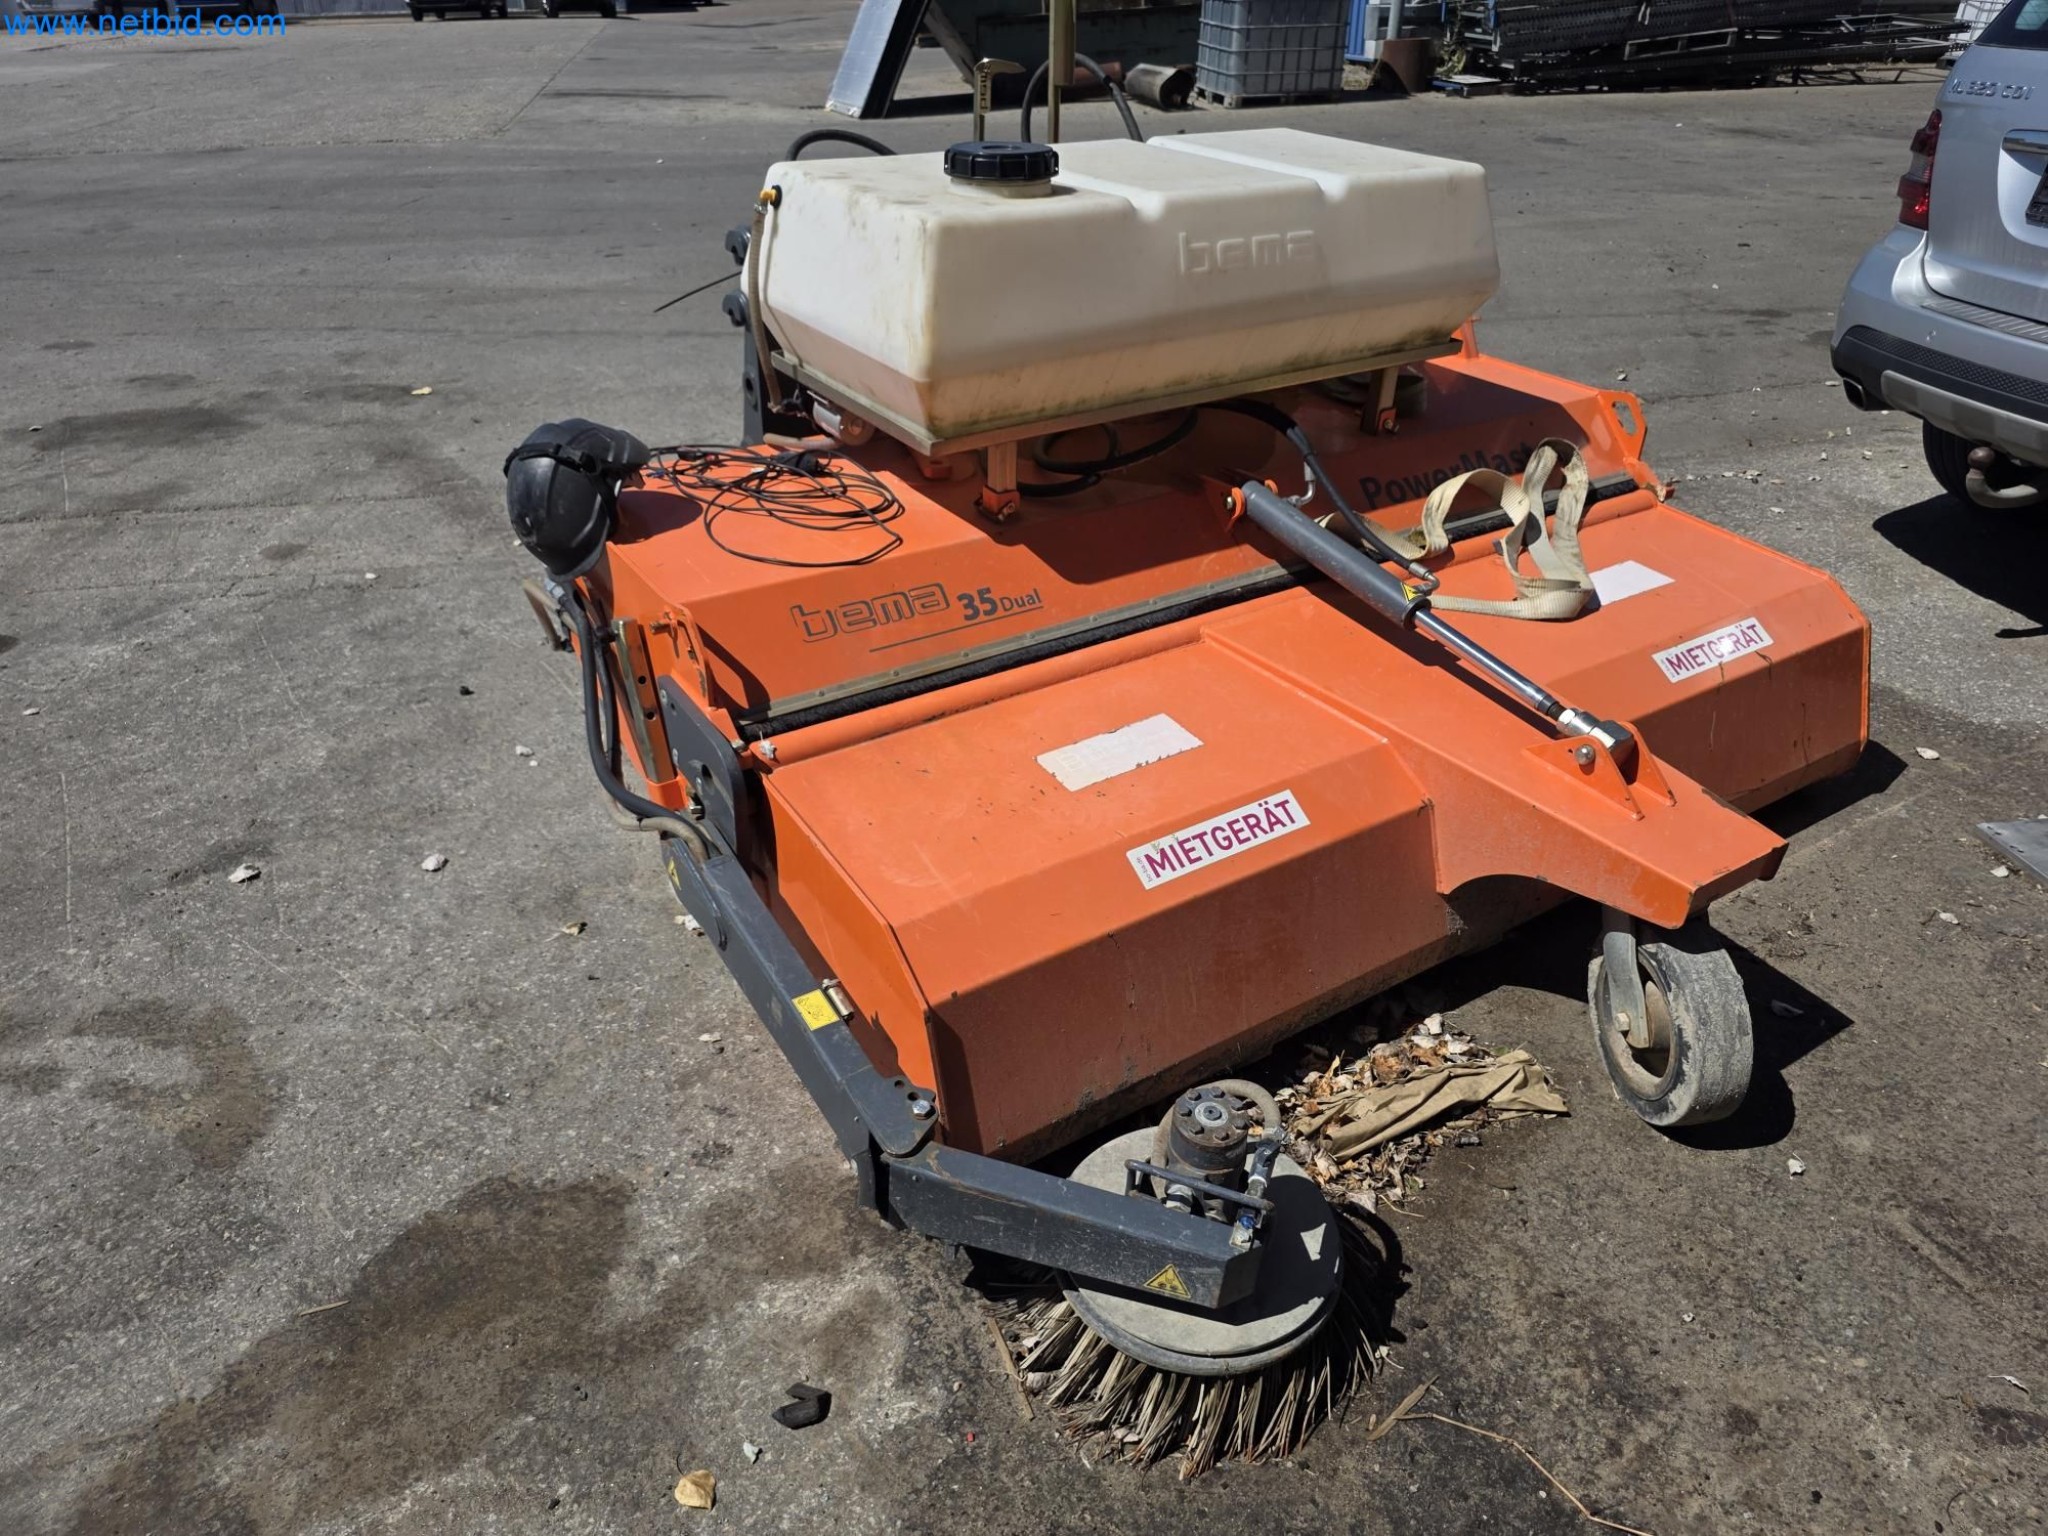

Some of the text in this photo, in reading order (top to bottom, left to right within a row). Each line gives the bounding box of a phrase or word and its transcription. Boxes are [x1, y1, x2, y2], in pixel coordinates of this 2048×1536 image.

[2001, 84, 2037, 100] CDI
[1178, 229, 1315, 275] bema
[1359, 441, 1532, 511] PowerMast
[790, 583, 1043, 643] bema 35 Dual
[1143, 799, 1298, 879] MIETGERÄT
